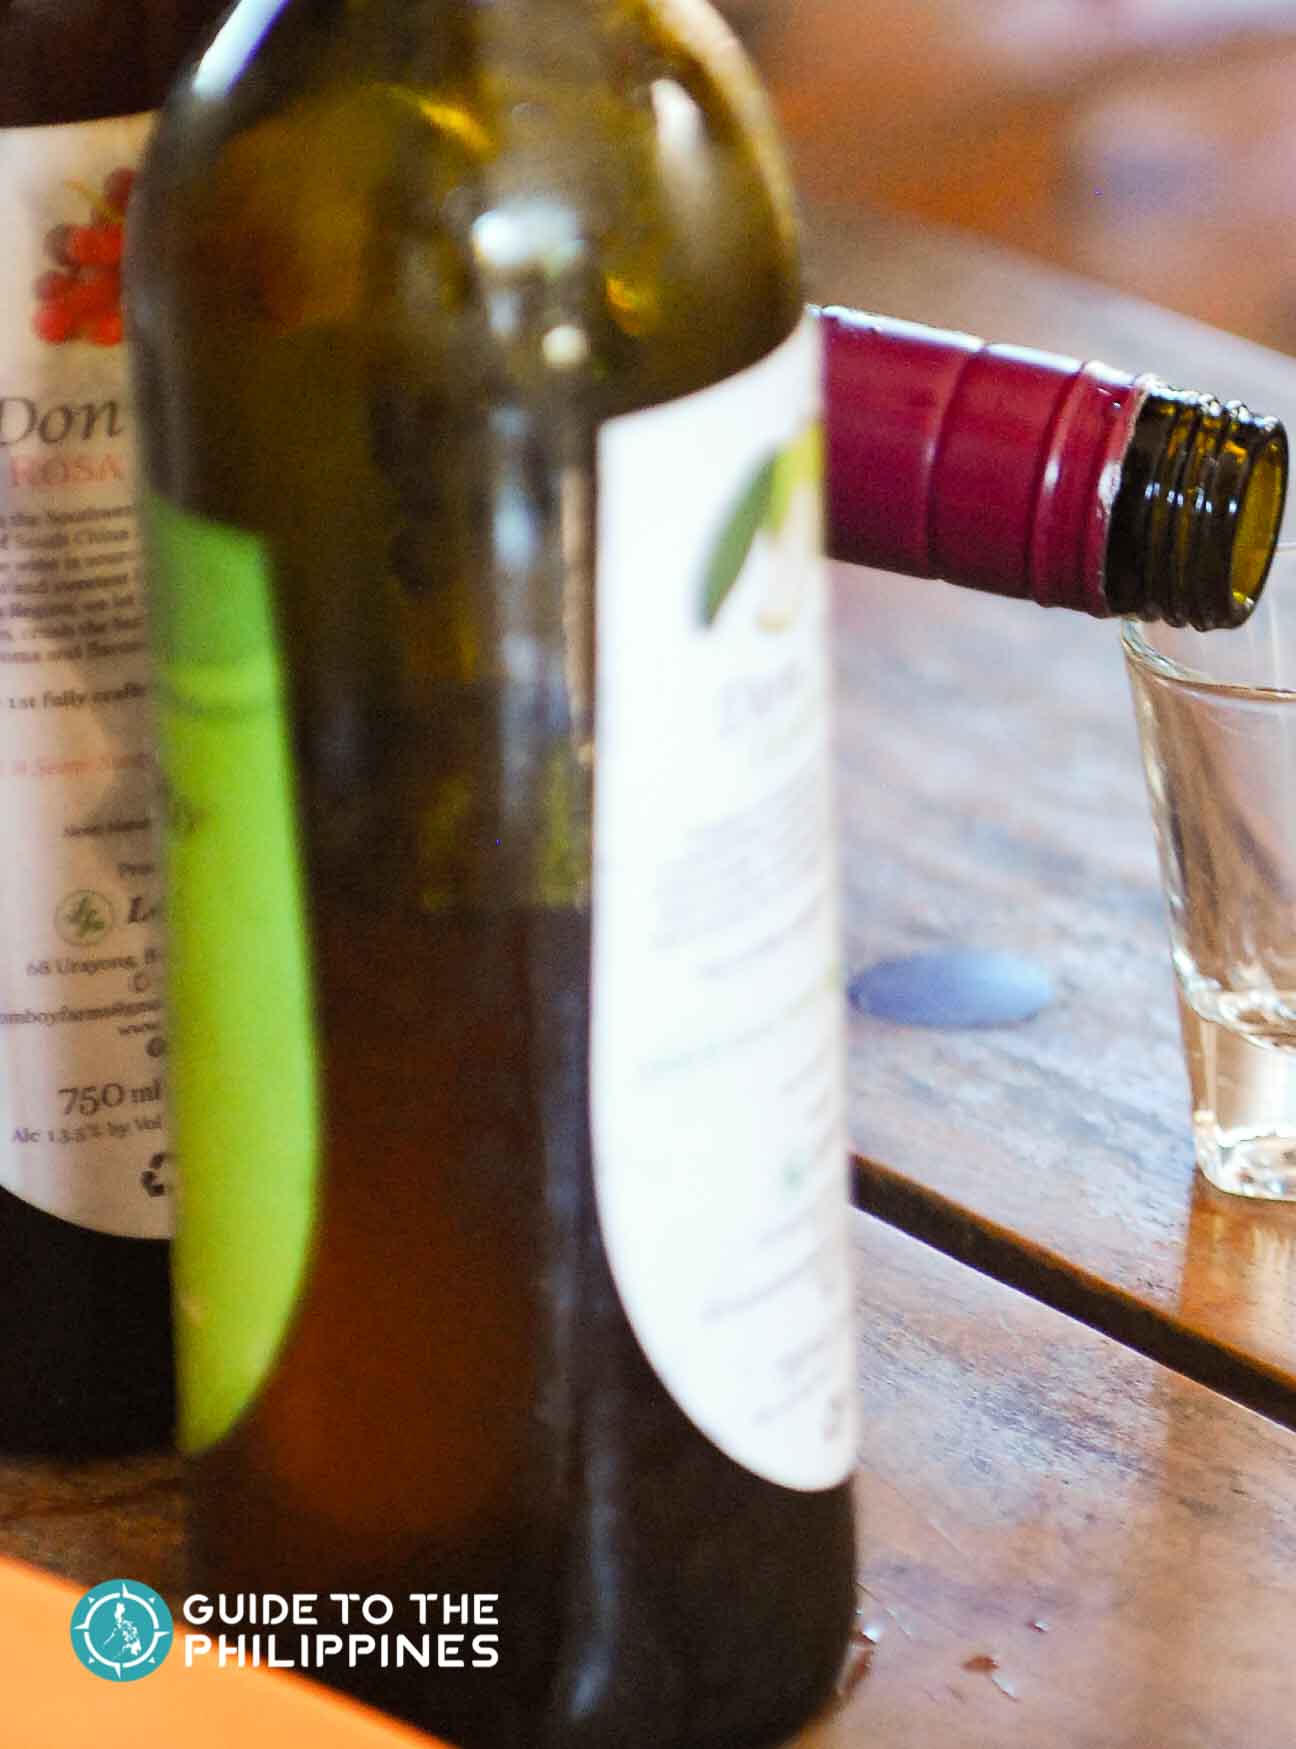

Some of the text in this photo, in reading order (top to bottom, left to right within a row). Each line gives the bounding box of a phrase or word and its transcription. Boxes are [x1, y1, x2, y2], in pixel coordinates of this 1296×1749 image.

[0, 396, 123, 446] Don
[9, 453, 126, 488] ROSA
[58, 1078, 163, 1118] 750 ml
[11, 1126, 41, 1145] Alc
